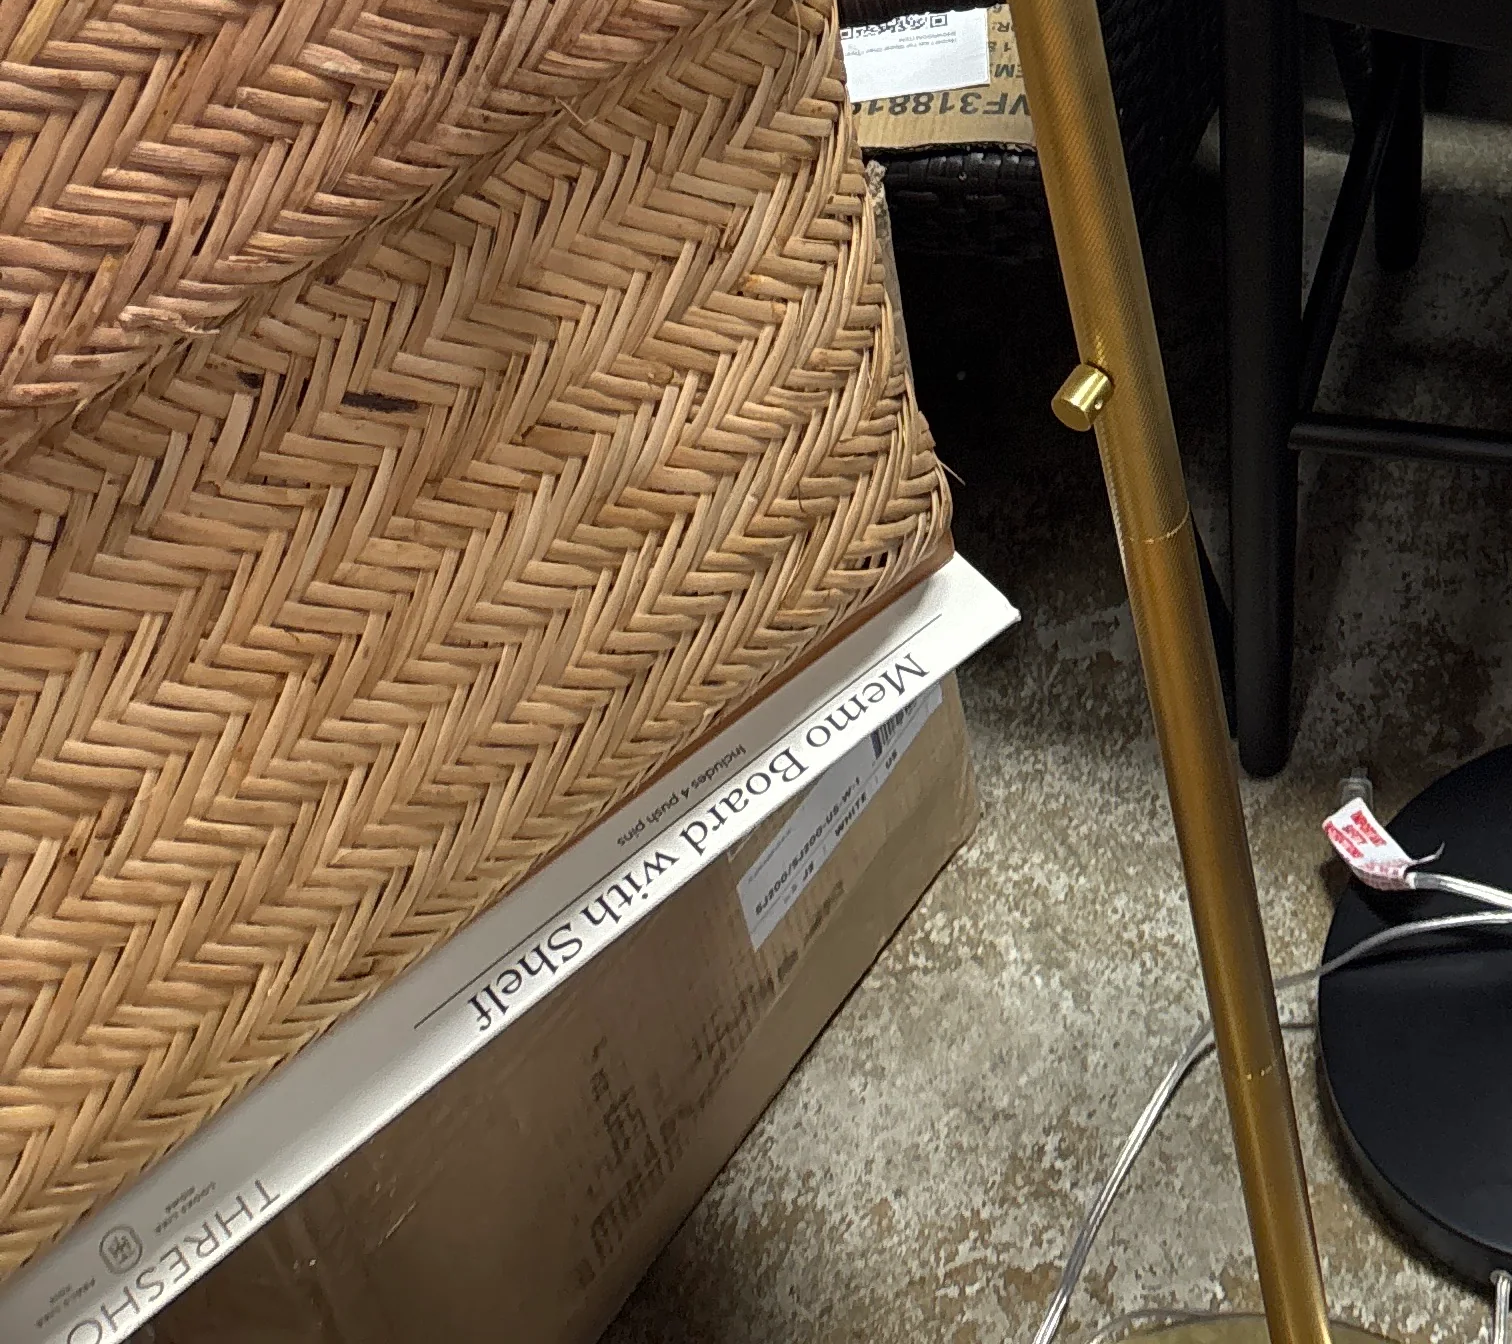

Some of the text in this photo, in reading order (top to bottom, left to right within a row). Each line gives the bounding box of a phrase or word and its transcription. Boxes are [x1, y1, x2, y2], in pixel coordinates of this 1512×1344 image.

[805, 652, 930, 748] Memo
[616, 743, 747, 847] Includes 4 push pins
[679, 746, 809, 856] Board
[579, 850, 680, 925] with
[467, 922, 584, 1032] Shelf
[67, 1179, 280, 1344] THRESHO
